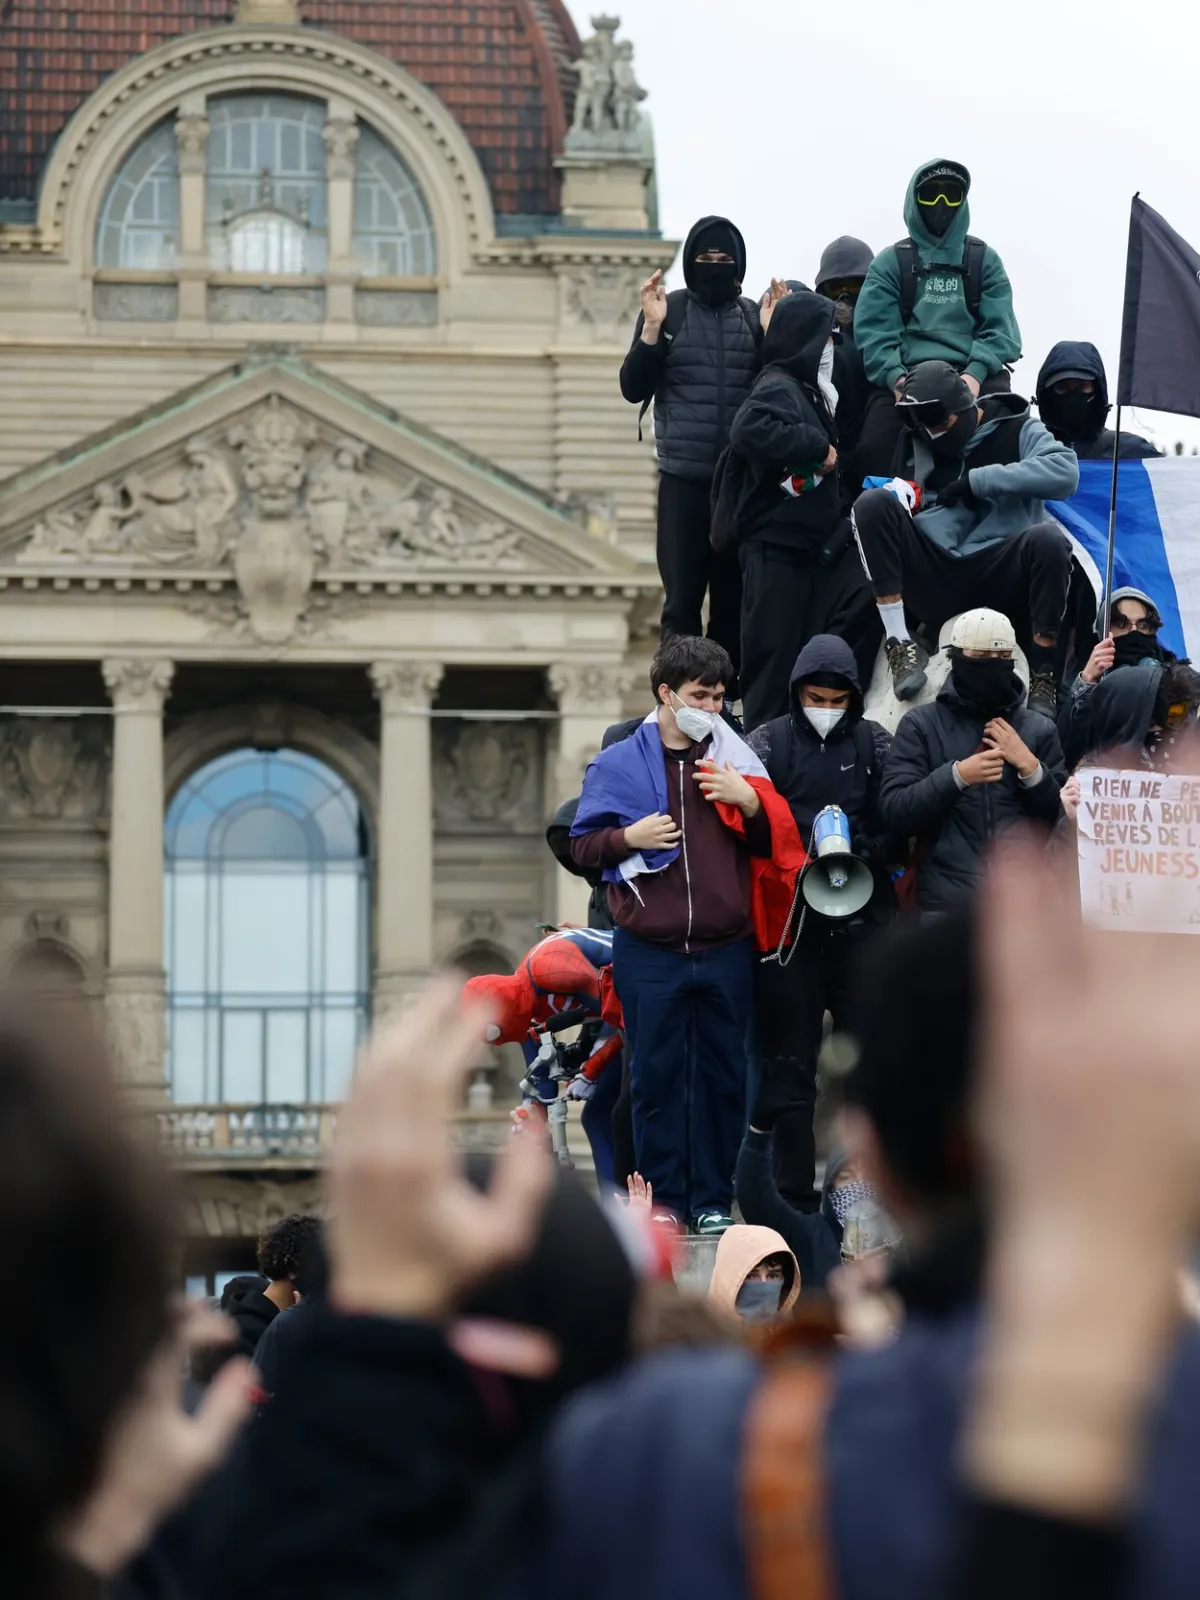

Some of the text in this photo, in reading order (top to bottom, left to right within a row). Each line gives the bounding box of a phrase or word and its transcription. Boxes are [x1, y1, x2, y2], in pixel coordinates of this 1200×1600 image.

[1093, 776, 1131, 798] RIEN
[1139, 781, 1162, 799] NE
[1085, 801, 1137, 822] VENIR
[1142, 800, 1153, 822] À
[1157, 826, 1180, 847] DE
